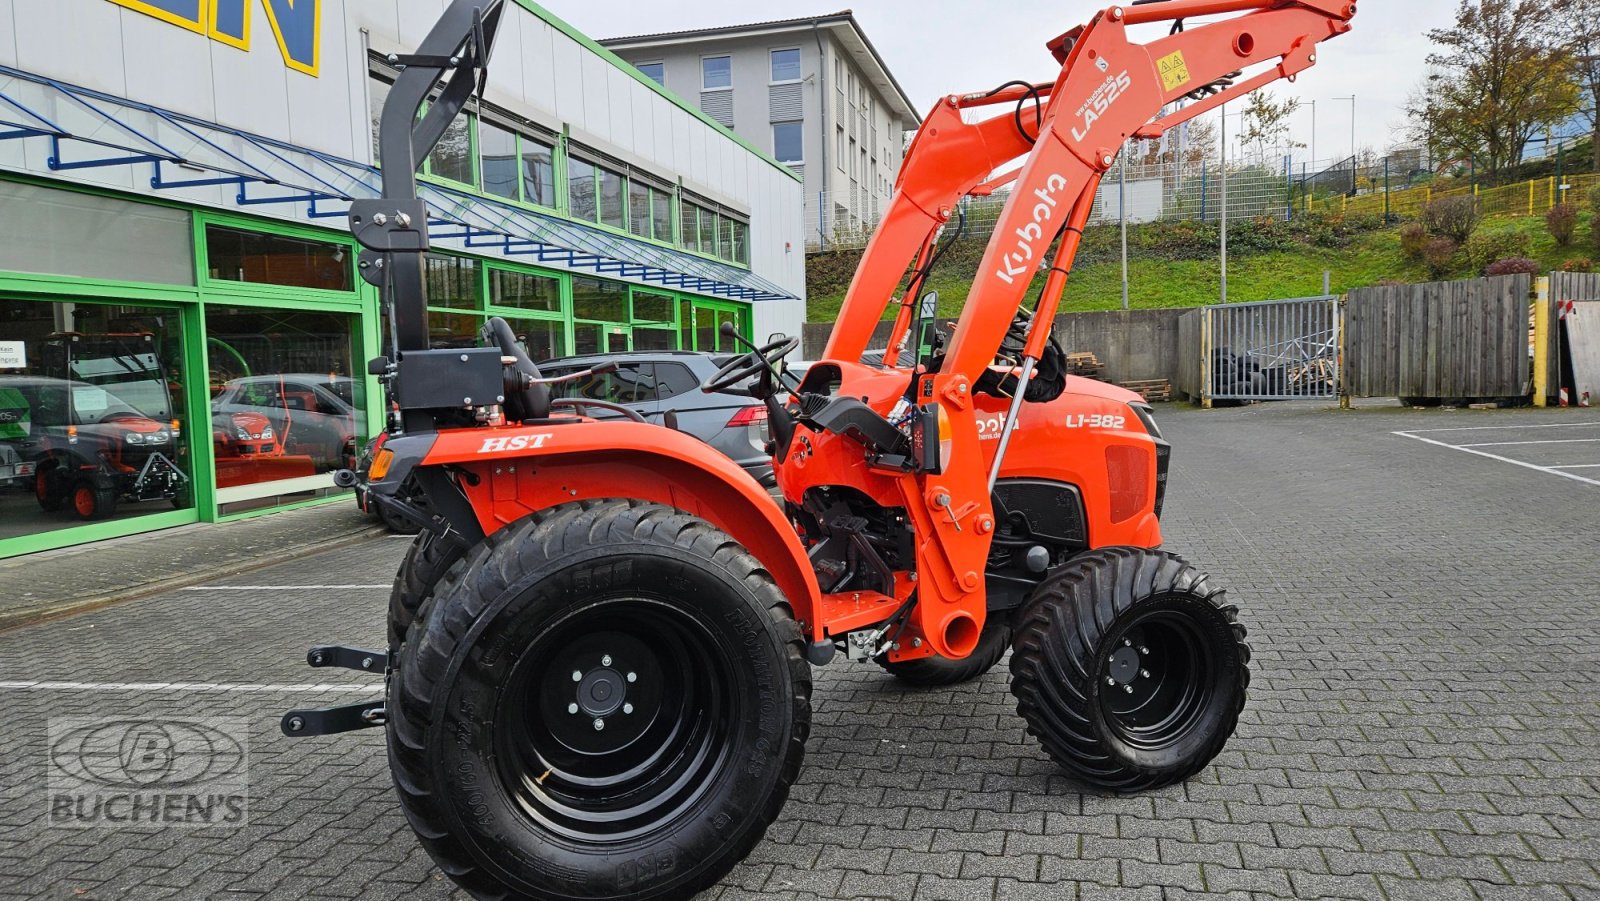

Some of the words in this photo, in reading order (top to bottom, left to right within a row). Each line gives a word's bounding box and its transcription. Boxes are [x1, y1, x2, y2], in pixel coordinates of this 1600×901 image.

[1071, 69, 1131, 142] LA525
[996, 173, 1067, 284] Kubota
[477, 433, 553, 453] HST
[1065, 414, 1125, 429] L1-382
